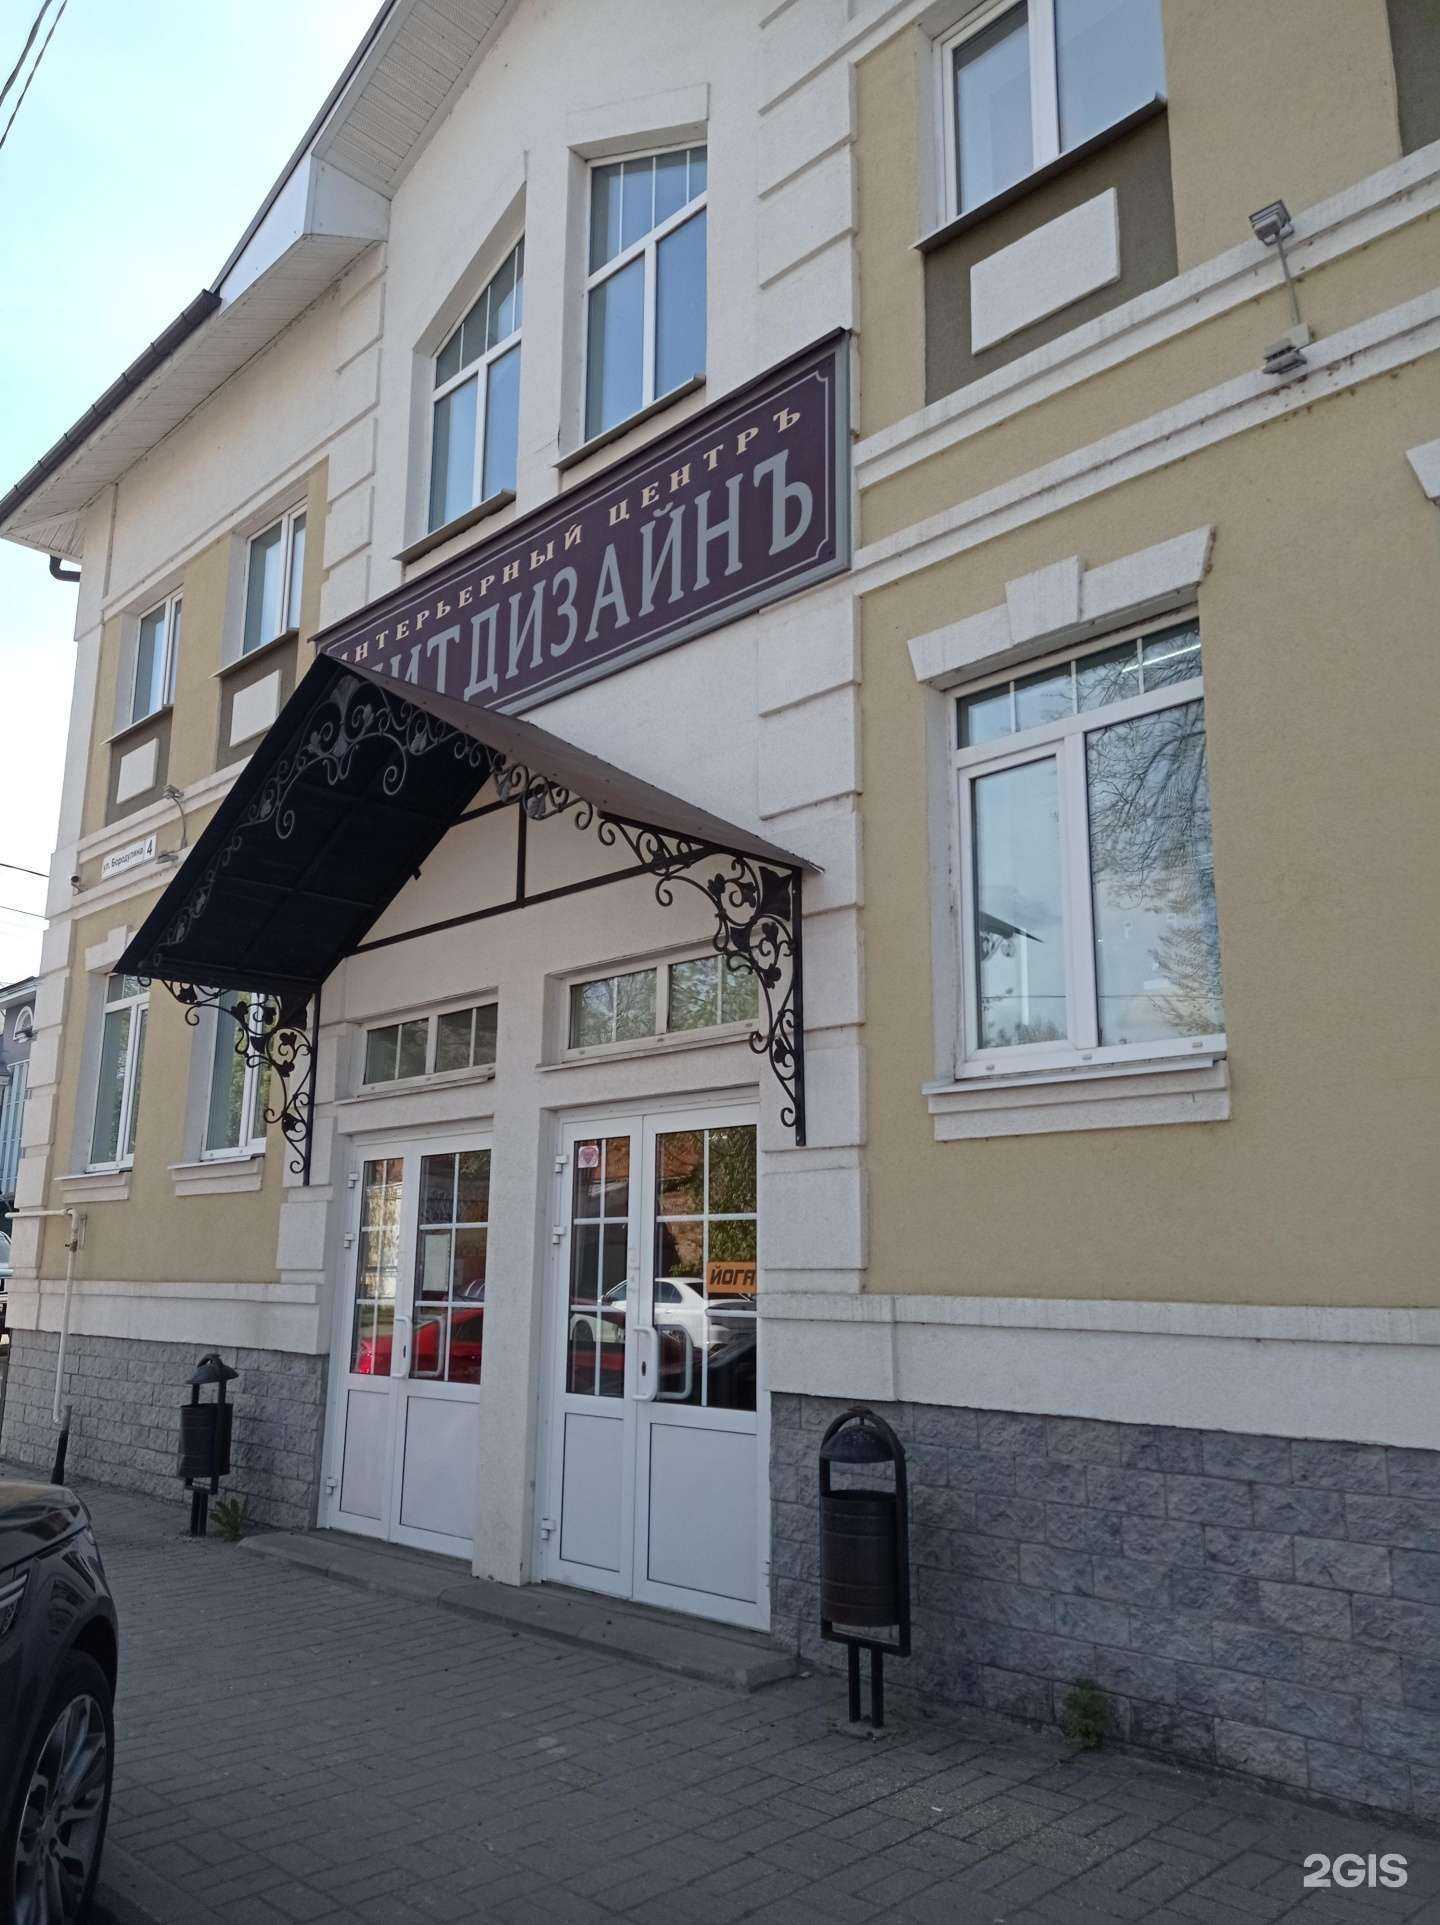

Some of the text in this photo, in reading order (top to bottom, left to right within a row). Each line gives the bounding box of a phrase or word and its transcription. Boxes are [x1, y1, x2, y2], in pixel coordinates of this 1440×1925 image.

[609, 406, 802, 526] ЦЕНТРЪ
[371, 448, 814, 702] ТДИЗАЙНЪ
[146, 839, 153, 856] 4
[710, 1264, 755, 1286] ЙОГА
